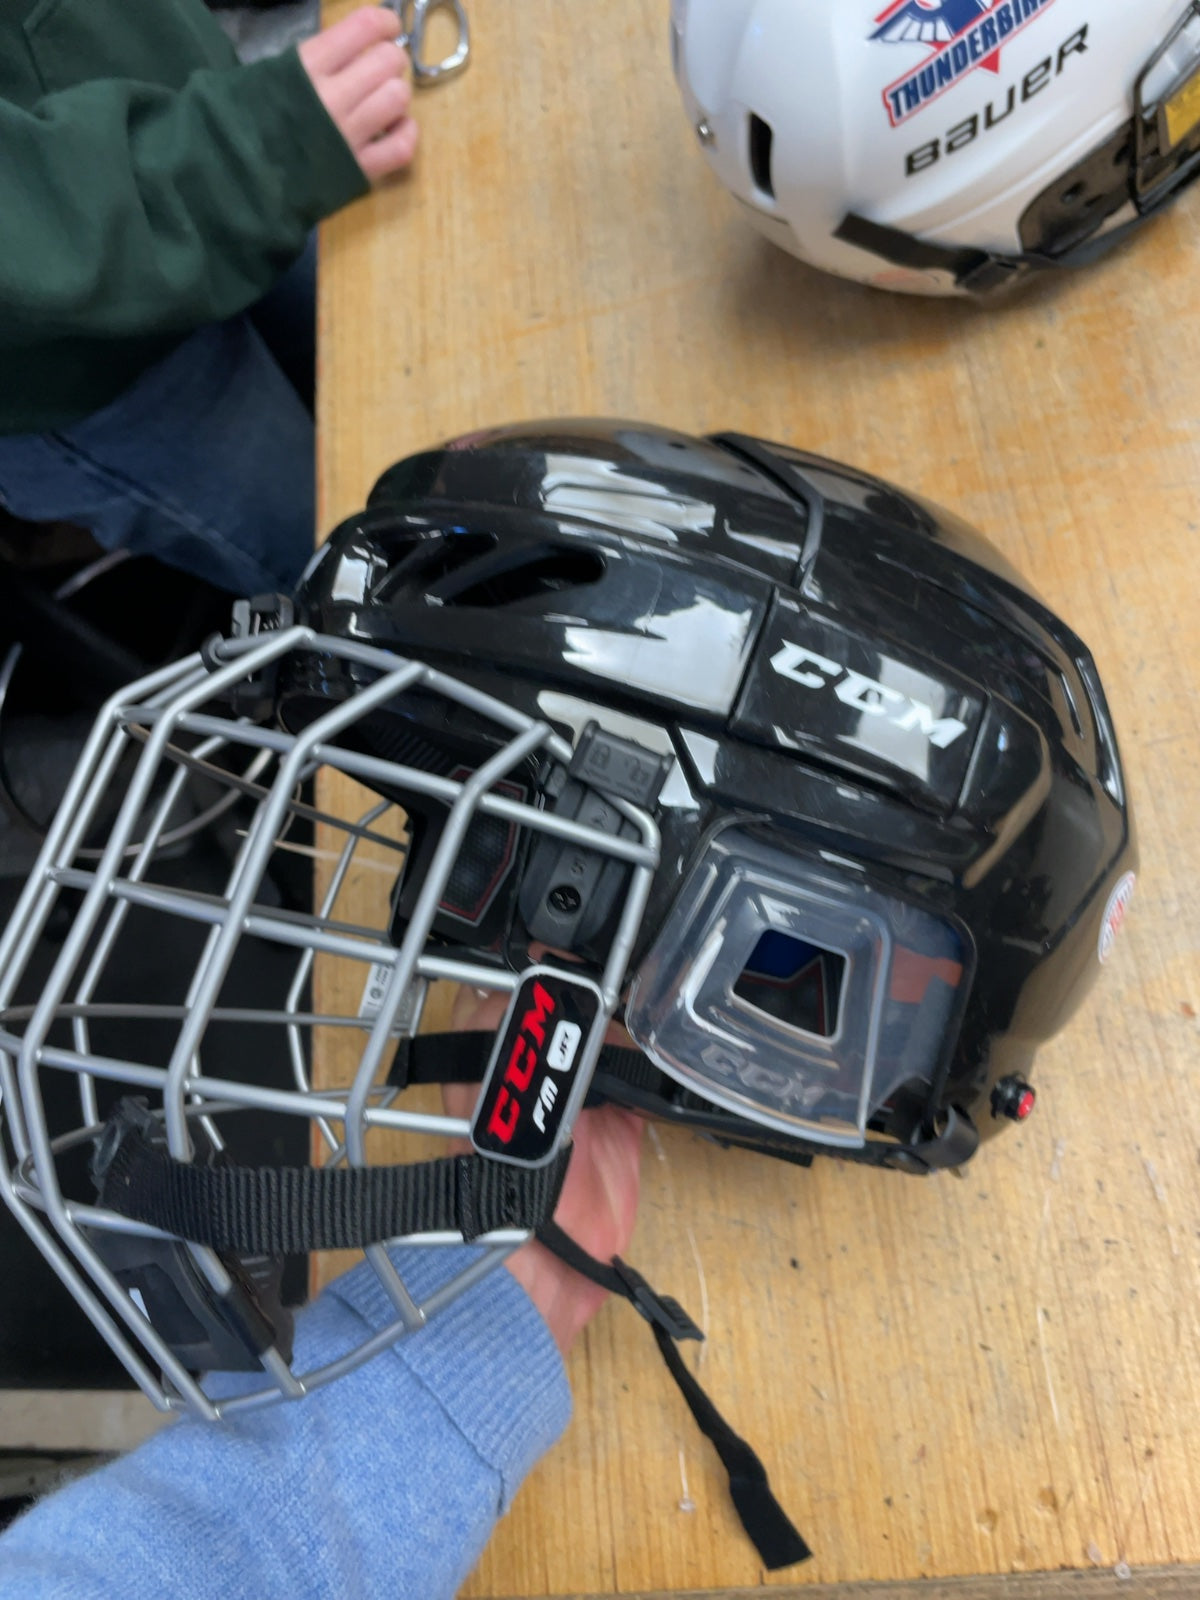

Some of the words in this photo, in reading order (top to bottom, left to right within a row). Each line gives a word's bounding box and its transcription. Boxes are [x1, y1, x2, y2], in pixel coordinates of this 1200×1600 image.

[888, 0, 1048, 119] THUNDERBI
[770, 639, 967, 749] CCM
[487, 981, 556, 1143] CCM
[533, 1075, 559, 1134] FM
